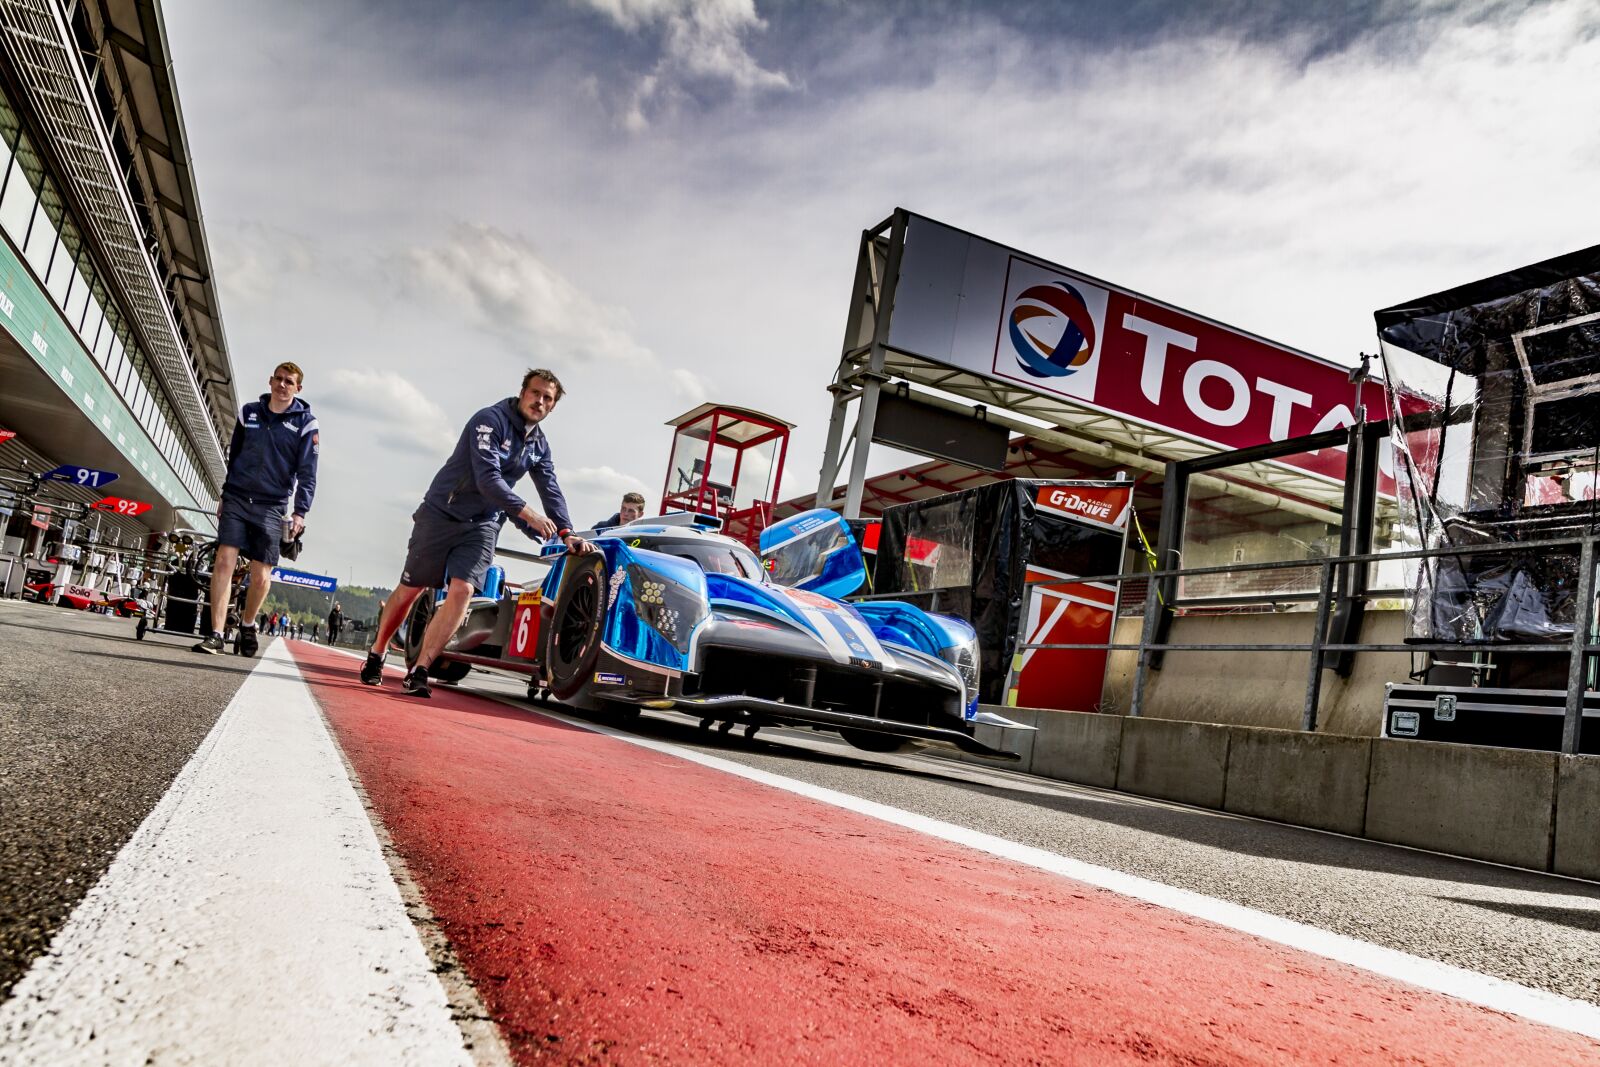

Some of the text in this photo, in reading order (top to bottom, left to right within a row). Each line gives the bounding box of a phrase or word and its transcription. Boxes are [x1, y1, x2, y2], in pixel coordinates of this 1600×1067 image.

[77, 468, 100, 487] 91
[118, 500, 139, 515] 92
[1086, 498, 1113, 509] RACING
[282, 574, 333, 588] MICHELIN
[94, 604, 106, 614] 31
[516, 607, 531, 653] 6
